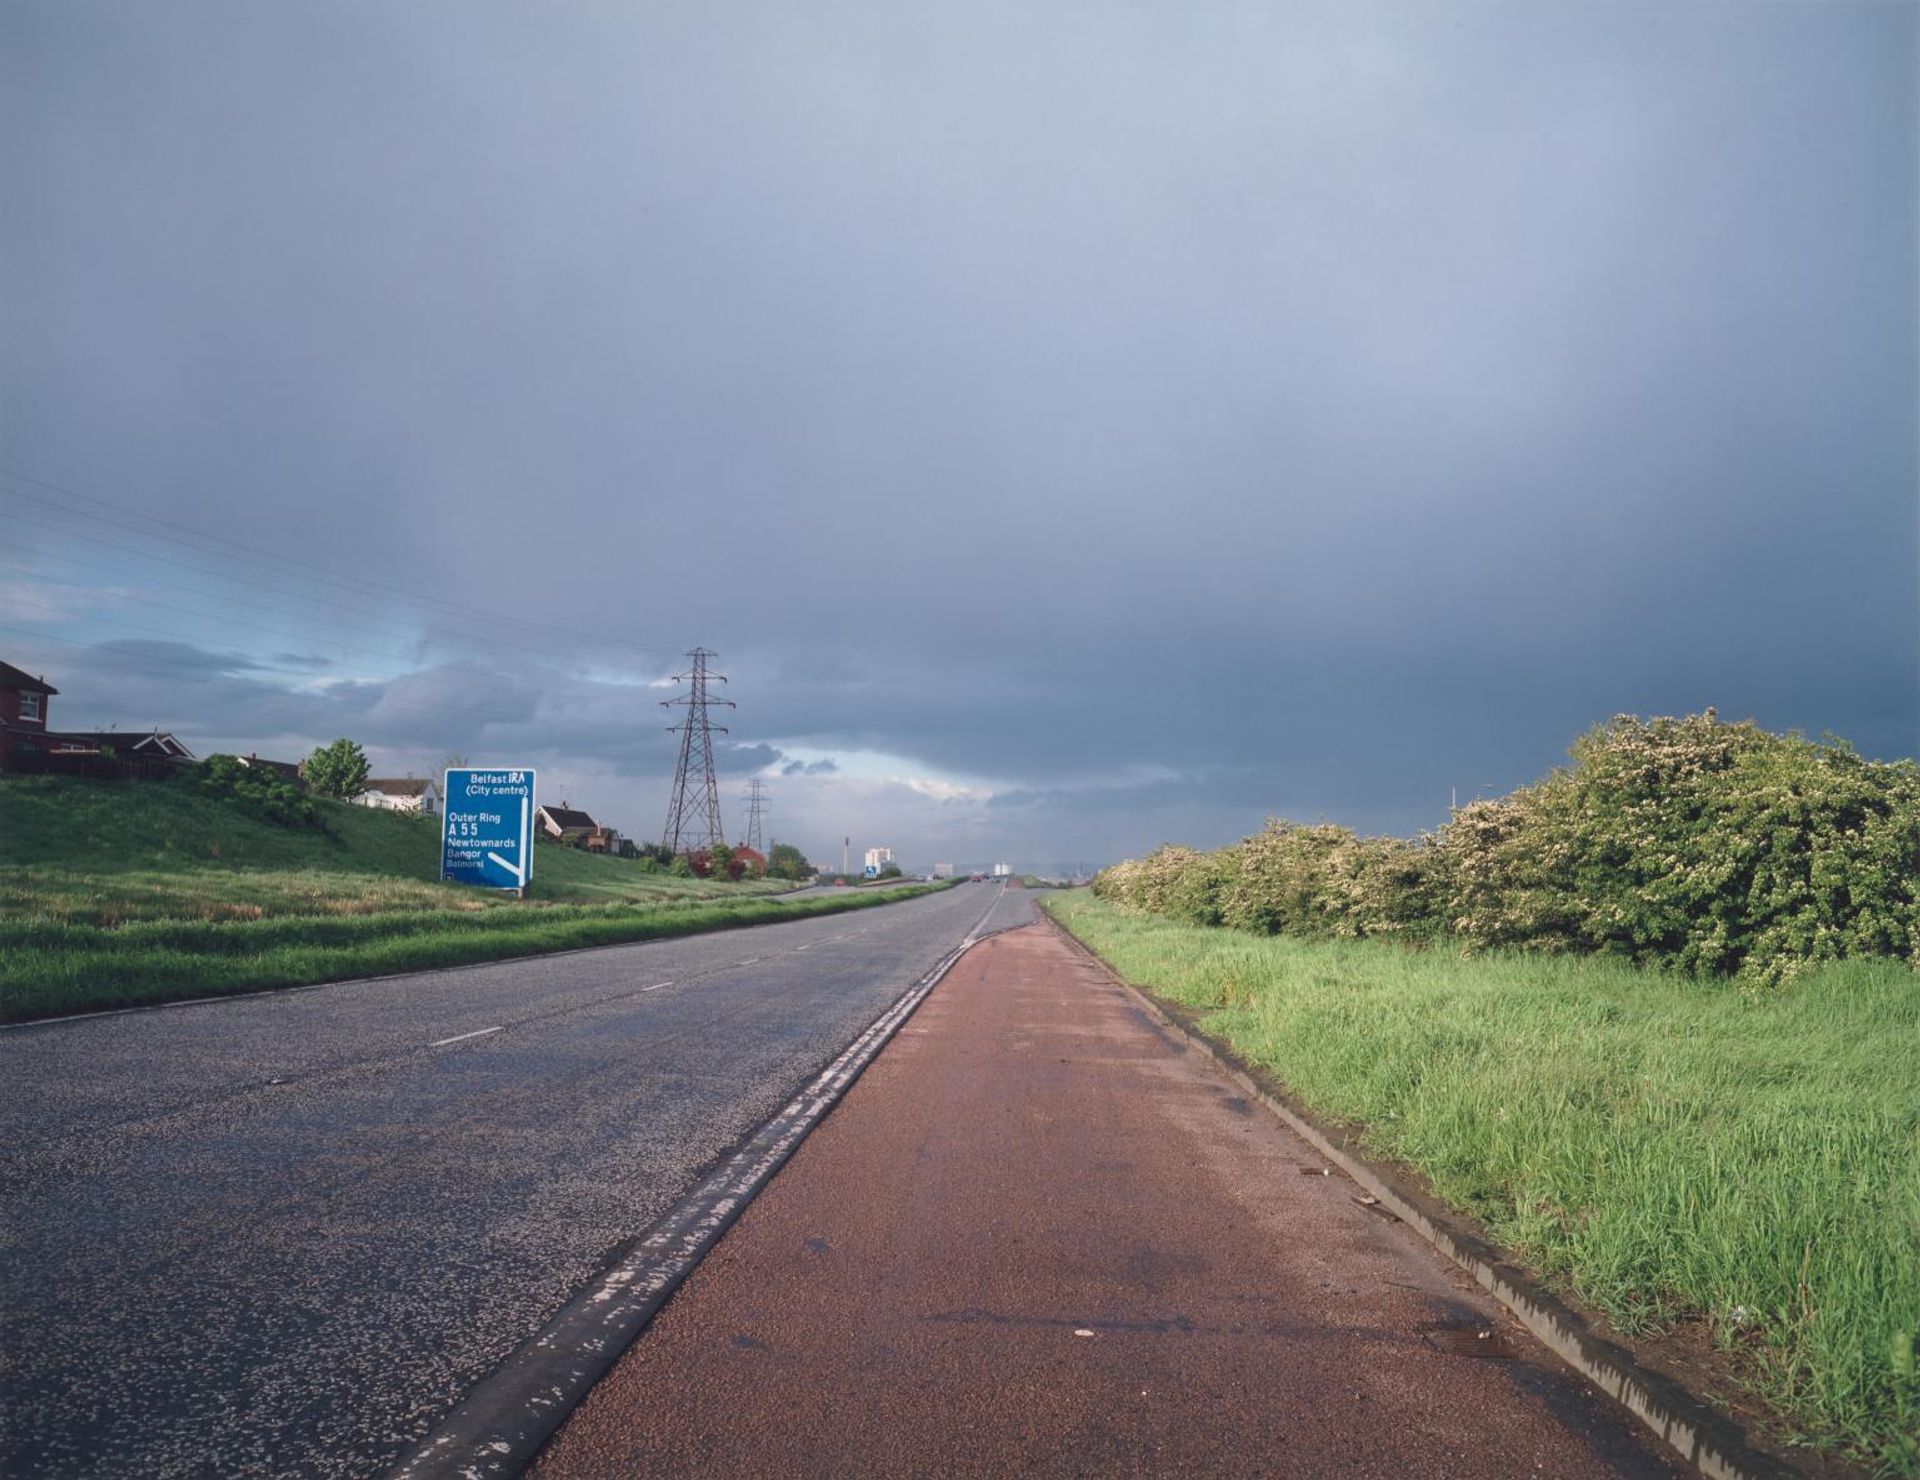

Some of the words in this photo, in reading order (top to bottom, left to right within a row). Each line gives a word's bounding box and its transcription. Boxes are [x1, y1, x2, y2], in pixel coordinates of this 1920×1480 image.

[470, 773, 507, 784] Belfast
[508, 772, 525, 784] IRA
[465, 785, 490, 796] (City
[492, 785, 529, 796] centre)
[448, 812, 478, 822] Outer
[479, 813, 501, 824] Ring
[448, 838, 516, 848] Newtownards
[447, 849, 481, 860] Bangor
[446, 859, 484, 869] Balmoral
